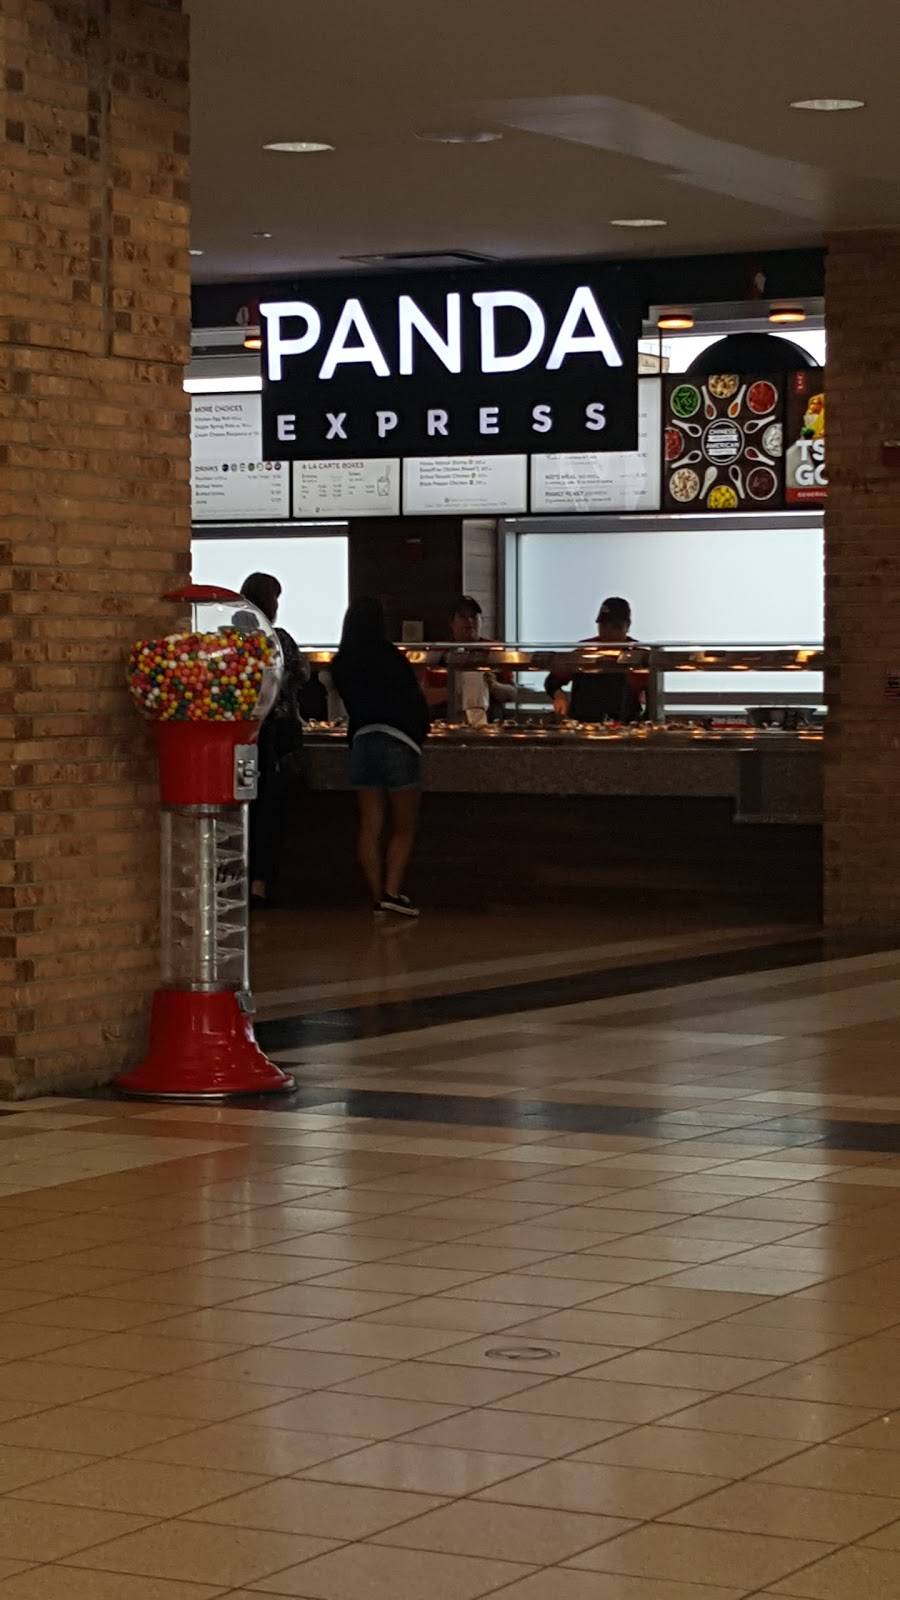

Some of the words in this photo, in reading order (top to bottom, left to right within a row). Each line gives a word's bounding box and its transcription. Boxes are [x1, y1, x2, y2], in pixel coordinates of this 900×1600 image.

[259, 286, 623, 381] PANDA
[277, 403, 606, 441] EXPRESS
[342, 461, 365, 469] BOXES
